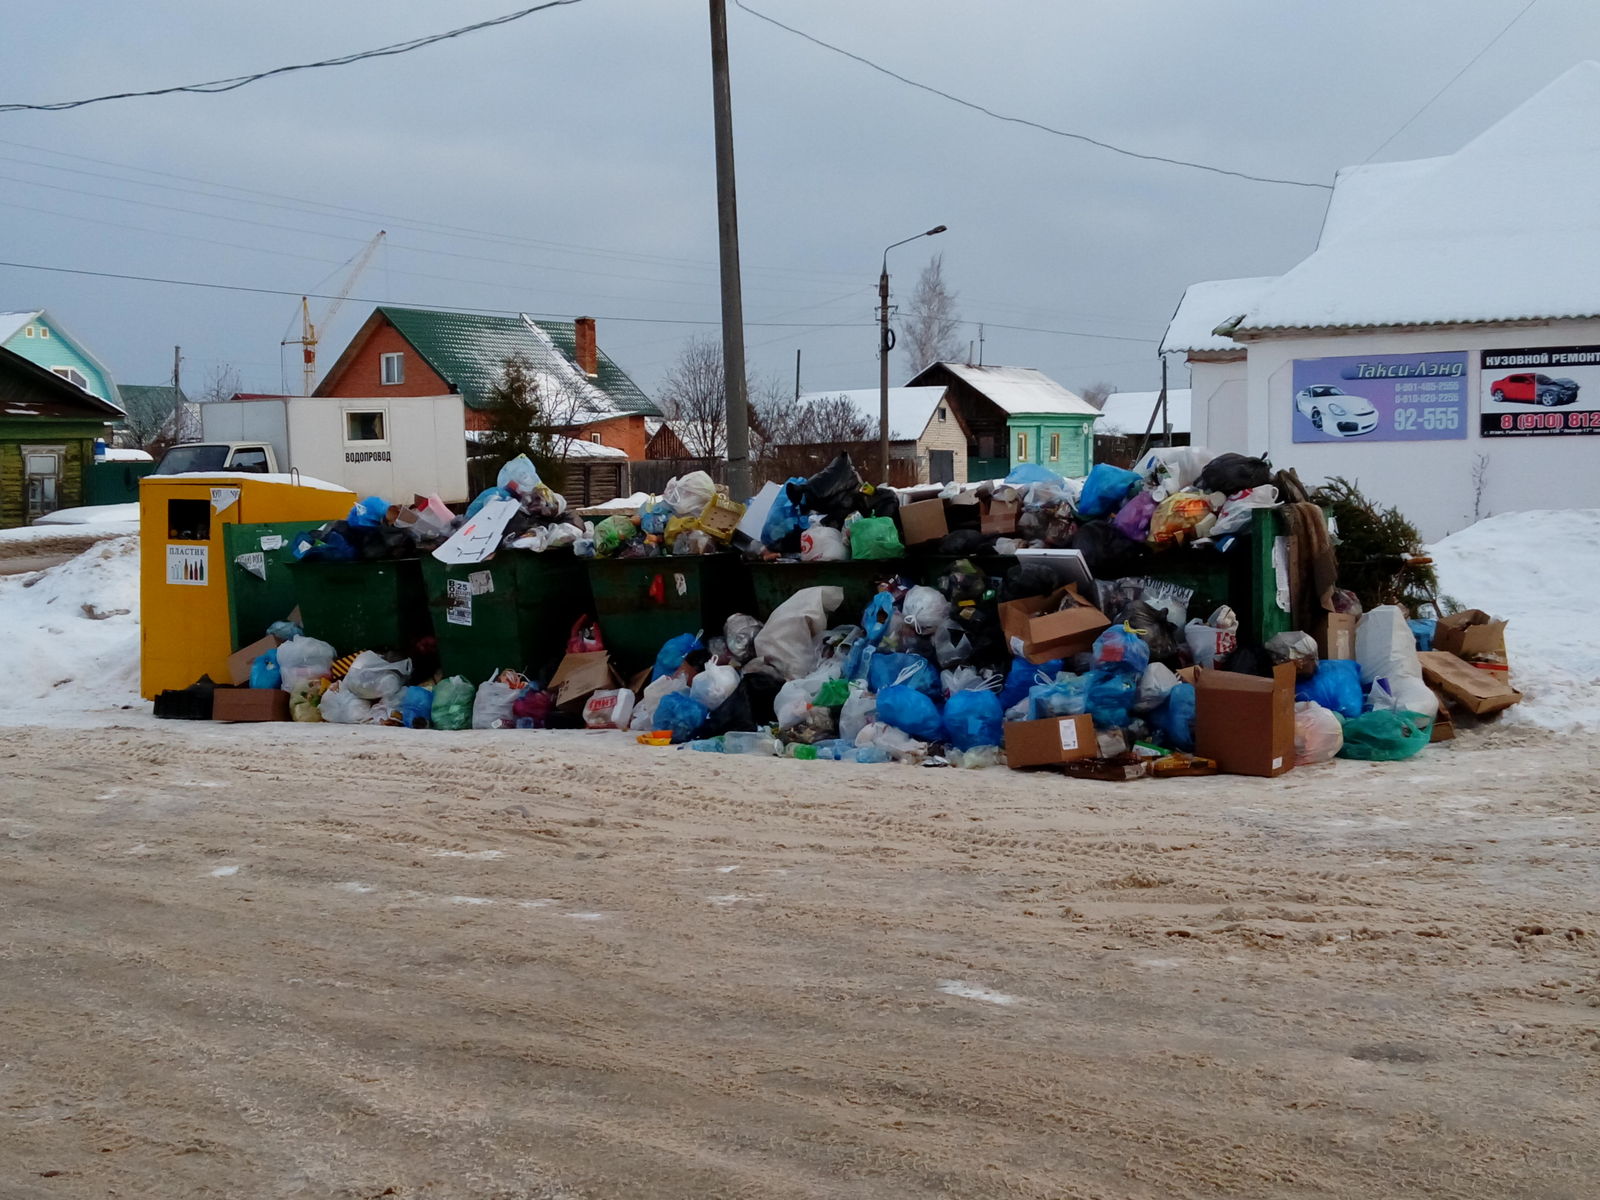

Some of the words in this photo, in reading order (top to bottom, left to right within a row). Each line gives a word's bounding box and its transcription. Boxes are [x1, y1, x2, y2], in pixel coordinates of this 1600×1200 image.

[1486, 353, 1549, 366] КУЗОВНОЙ
[1357, 362, 1463, 378] Такси-Лэнд
[1394, 407, 1459, 431] 92-555
[1501, 414, 1513, 429] 8
[1517, 413, 1564, 430] (910)
[345, 451, 392, 464] ВОДОПРОВОД
[169, 547, 205, 556] ПЛАСТИК
